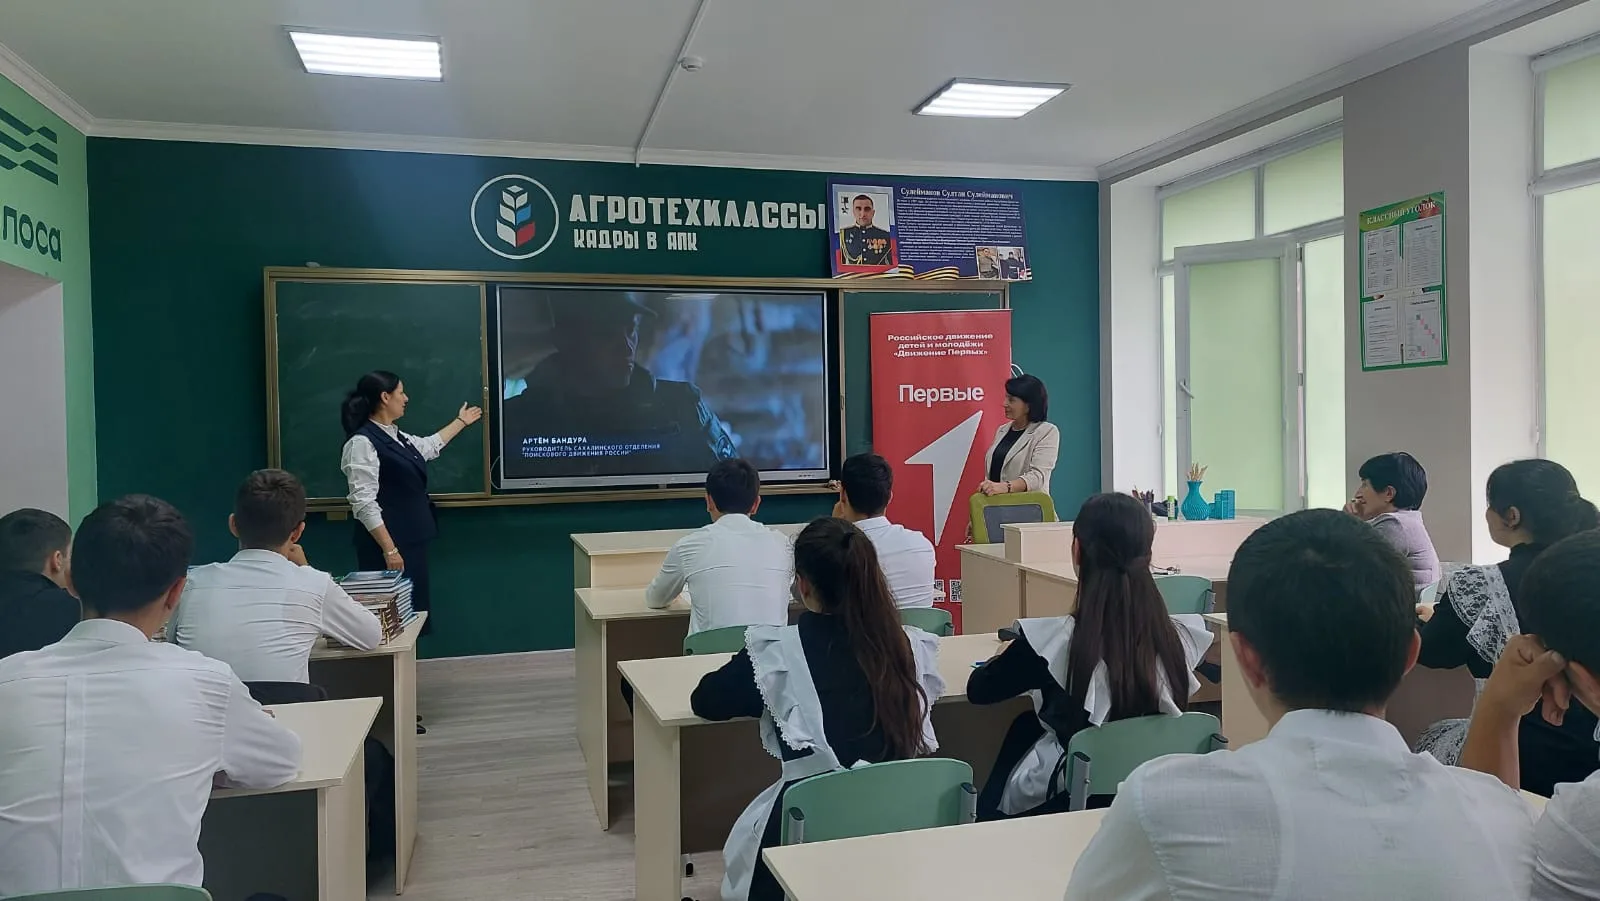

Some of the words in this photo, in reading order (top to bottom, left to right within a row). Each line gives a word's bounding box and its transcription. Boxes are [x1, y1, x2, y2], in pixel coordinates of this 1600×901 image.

[569, 194, 826, 230] АГРОТЕХКЛАССЫ
[574, 229, 640, 250] КАДРЫ
[647, 231, 658, 250] В
[668, 232, 698, 251] АПК
[887, 334, 944, 342] Российское
[945, 333, 994, 341] движение
[897, 342, 926, 350] детей
[934, 340, 984, 349] молодёжи
[893, 350, 947, 358] «Движение
[947, 349, 988, 357] Первых»
[899, 384, 985, 408] Первые
